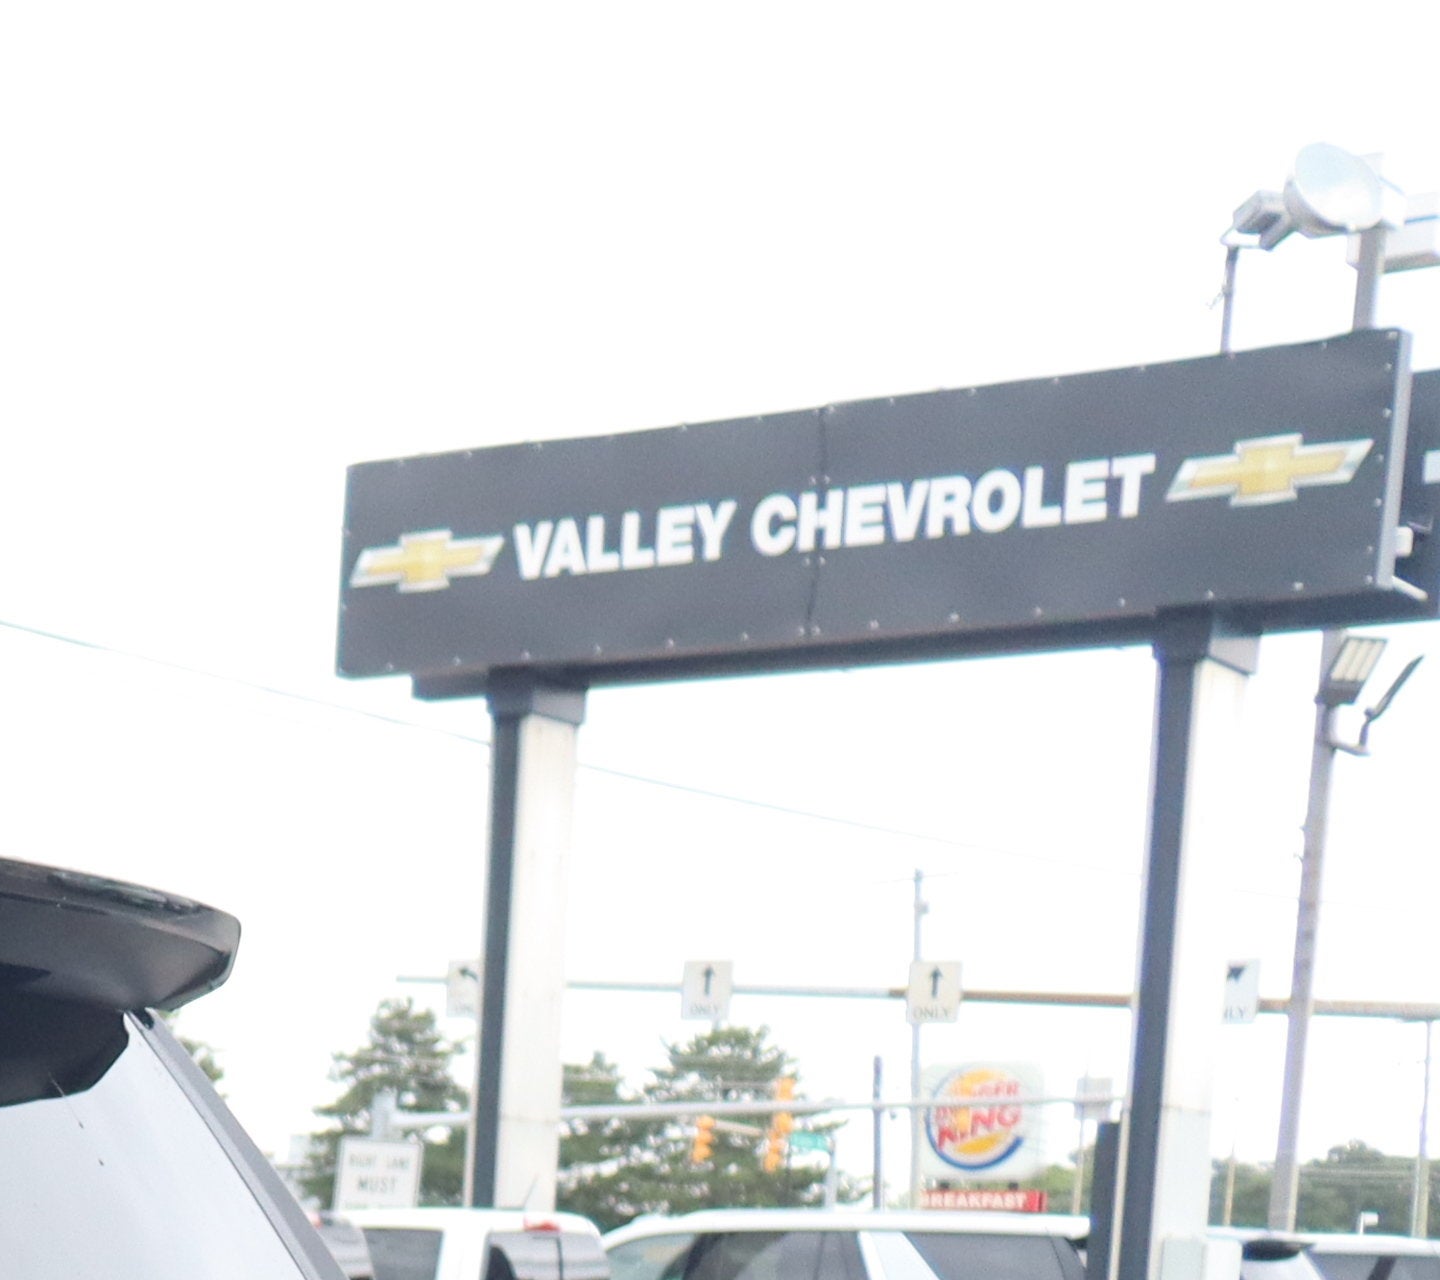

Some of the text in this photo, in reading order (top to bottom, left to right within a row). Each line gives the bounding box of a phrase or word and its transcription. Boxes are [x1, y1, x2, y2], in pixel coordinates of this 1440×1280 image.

[512, 453, 1157, 581] VALLEY CHEVROLET
[913, 1005, 952, 1020] ONLY
[936, 1103, 1022, 1151] KNG
